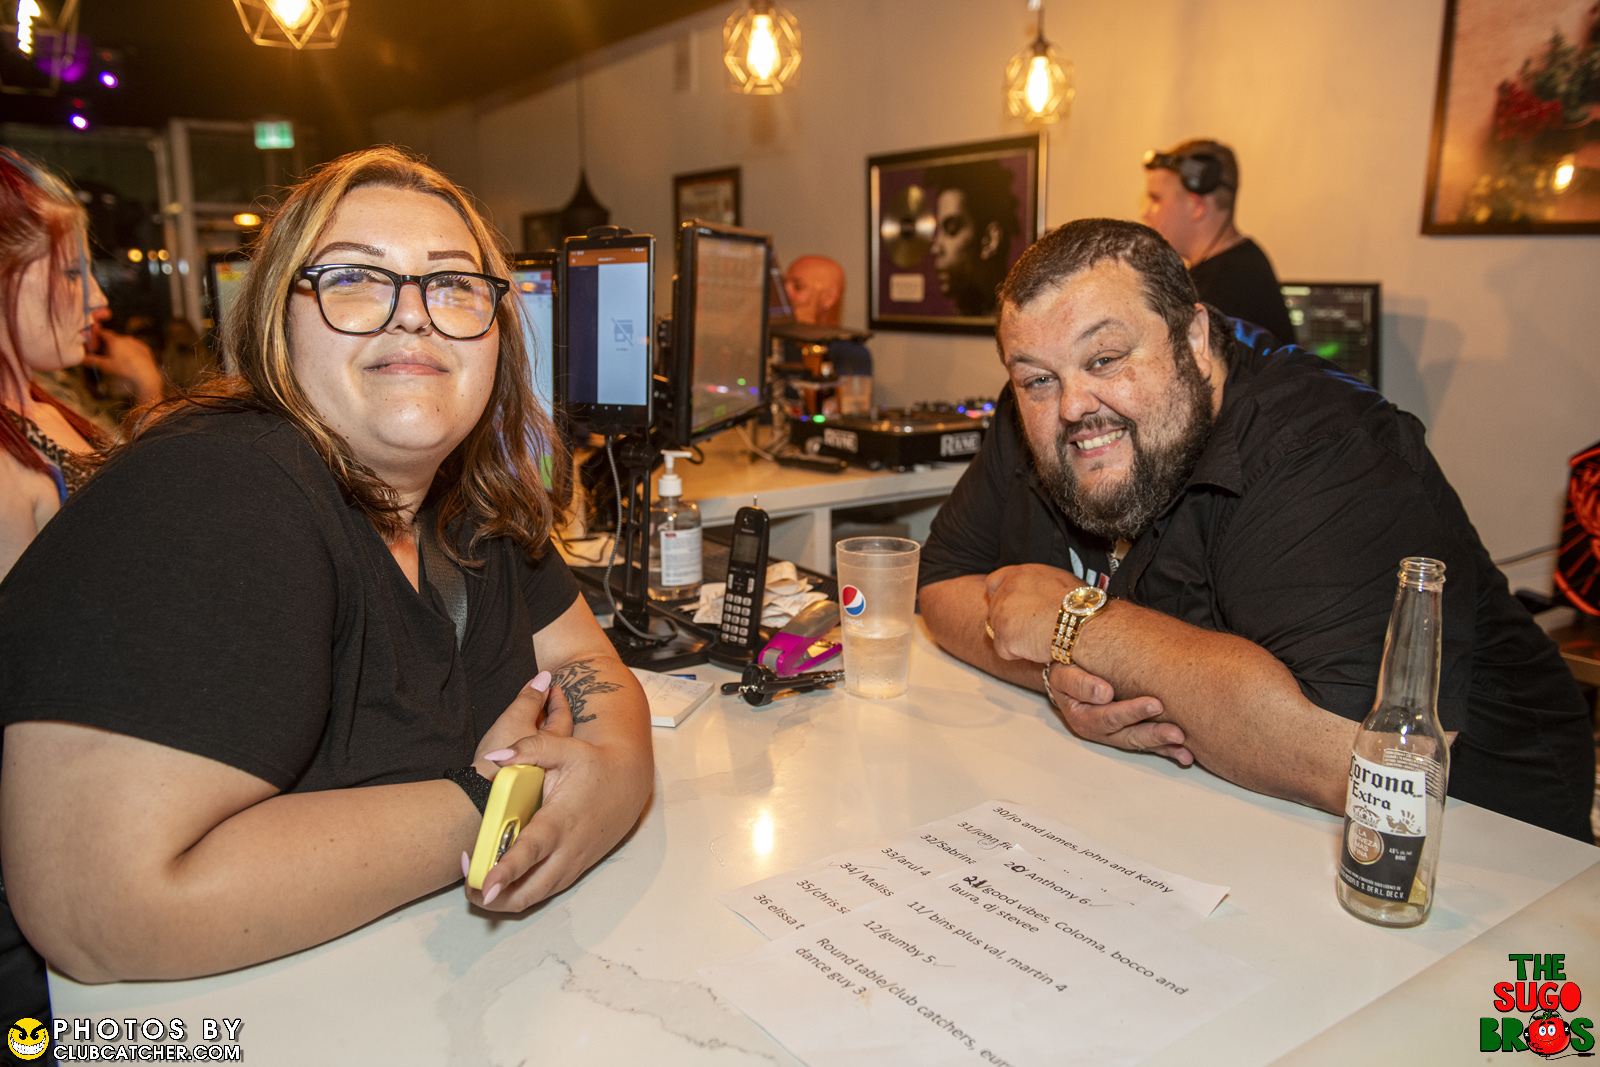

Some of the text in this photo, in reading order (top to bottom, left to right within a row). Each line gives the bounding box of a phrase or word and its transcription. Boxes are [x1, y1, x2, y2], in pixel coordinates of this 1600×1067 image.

[940, 431, 981, 457] RANE
[1352, 780, 1391, 811] Extra
[957, 821, 999, 844] 31/john
[992, 806, 1175, 894] 30/jo and james, john and Kathy
[881, 847, 931, 877] 33/arul 4
[753, 894, 773, 906] 36
[767, 904, 798, 926] elissa
[796, 879, 839, 908] 35/chris
[948, 882, 1040, 934] laura, dj stevee
[863, 919, 937, 964] 12/gumby 5
[928, 912, 955, 931] bins
[952, 927, 984, 947] plus
[983, 943, 1007, 960] val,
[1006, 956, 1054, 985] martin
[1055, 983, 1068, 993] 4
[1017, 903, 1050, 924] vibes,
[1054, 921, 1106, 954] Coloma,
[1110, 951, 1155, 978] bocco
[1155, 976, 1190, 995] and
[795, 947, 867, 995] dance guy 3
[816, 937, 859, 966] Round
[854, 962, 918, 1007] table/club
[917, 1004, 977, 1051] catchers,
